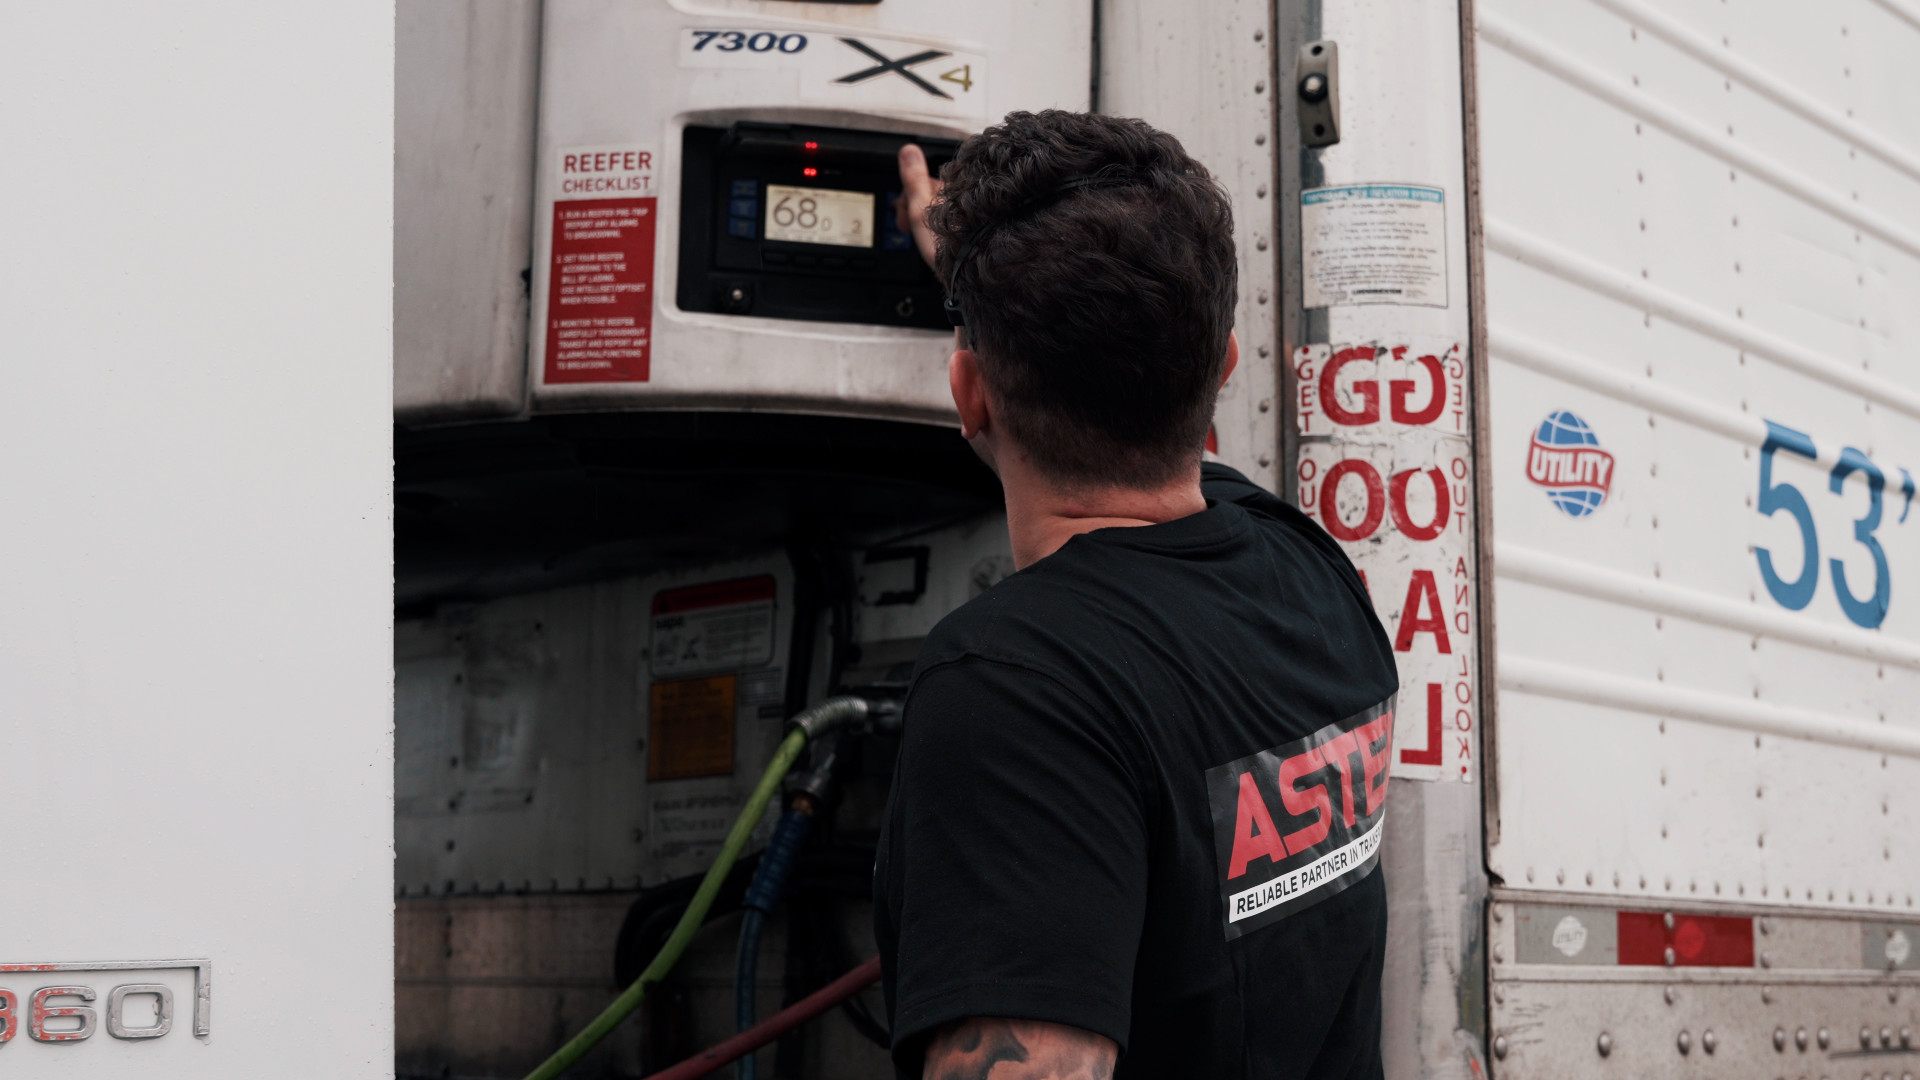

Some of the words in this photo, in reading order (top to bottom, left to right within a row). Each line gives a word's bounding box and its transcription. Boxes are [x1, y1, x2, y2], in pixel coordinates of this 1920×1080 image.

[692, 32, 807, 53] 7300
[564, 152, 652, 173] REEFER
[562, 176, 650, 193] CHECKLIST
[566, 210, 580, 218] RUN
[588, 208, 614, 217] REEFER
[774, 196, 818, 229] 68
[594, 219, 608, 228] ANY
[610, 218, 639, 228] ALARMS
[564, 231, 573, 240] TO
[563, 253, 578, 263] SET
[578, 252, 595, 262] YOUR
[597, 251, 624, 262] REEFER
[562, 263, 601, 274] ACCORDING
[603, 263, 611, 272] TO
[614, 262, 626, 272] THE
[561, 275, 576, 284] BILL
[578, 274, 587, 283] OF
[560, 285, 574, 294] USE
[560, 295, 580, 305] WHEN
[560, 318, 591, 328] MONITOR
[593, 318, 605, 327] THE
[607, 316, 634, 327] REEFER
[558, 329, 597, 338] CAREFULLY
[599, 327, 645, 337] THROUGHOUT
[558, 340, 587, 349] TRANSIT
[588, 339, 602, 348] AND
[604, 338, 631, 348] REPORT
[633, 338, 648, 347] ANY
[557, 361, 566, 370] TO
[1298, 359, 1314, 432] GET
[1530, 445, 1611, 486] UTILITY
[1299, 459, 1316, 518] OU
[1227, 709, 1394, 880] ASTE
[1236, 876, 1298, 915] RELIABLE
[1301, 852, 1348, 888] PARTNER
[1349, 845, 1359, 864] IN
[0, 983, 174, 1043] 60
